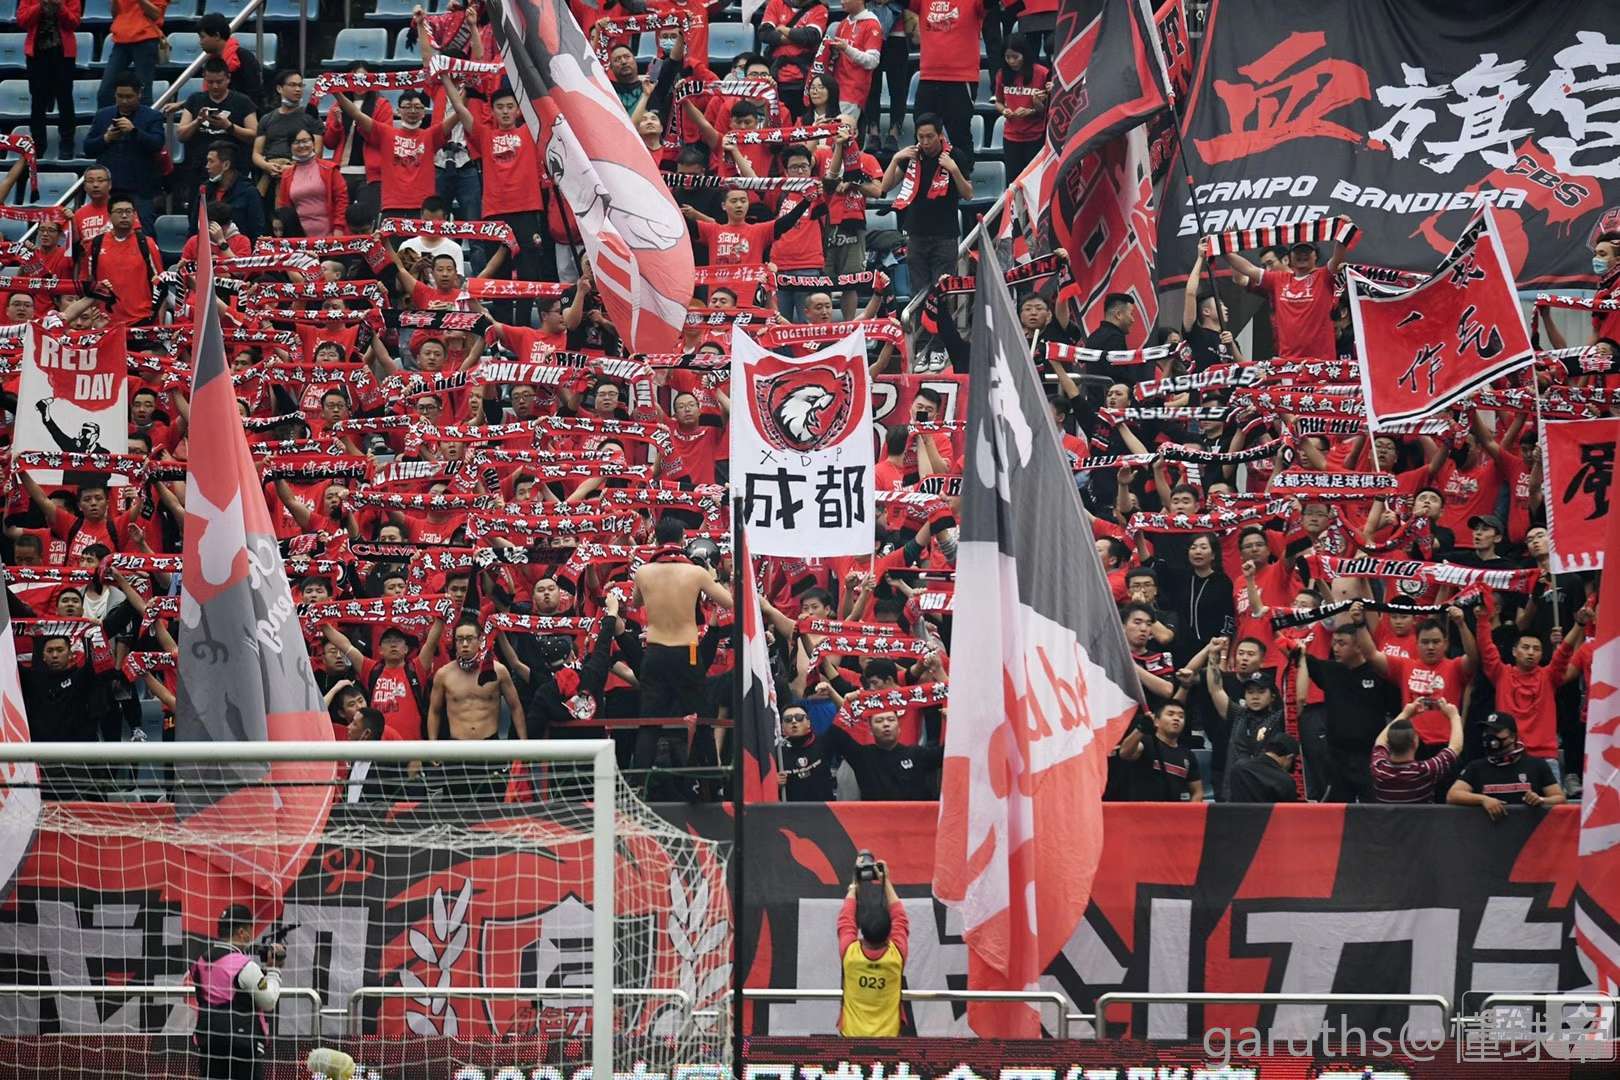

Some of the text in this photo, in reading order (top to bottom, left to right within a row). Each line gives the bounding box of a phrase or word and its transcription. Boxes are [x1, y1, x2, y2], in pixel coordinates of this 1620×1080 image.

[1186, 176, 1528, 215] CAMPO BANDIERA
[1505, 154, 1589, 207] CBS
[1177, 206, 1332, 238] SANGUE
[777, 275, 834, 288] CURVA
[838, 270, 874, 286] SUD
[775, 325, 828, 340] TOGETHER
[831, 323, 855, 336] FOR
[41, 335, 98, 370] RED
[75, 373, 115, 401] DAY
[486, 363, 527, 382] ONLY
[531, 365, 568, 386] ONE
[1140, 366, 1258, 398] CASUALS
[744, 465, 867, 529] 成都
[1336, 559, 1379, 576] TRUE
[1383, 560, 1424, 577] RED
[1437, 564, 1479, 587] ONLY
[858, 975, 886, 989] 023
